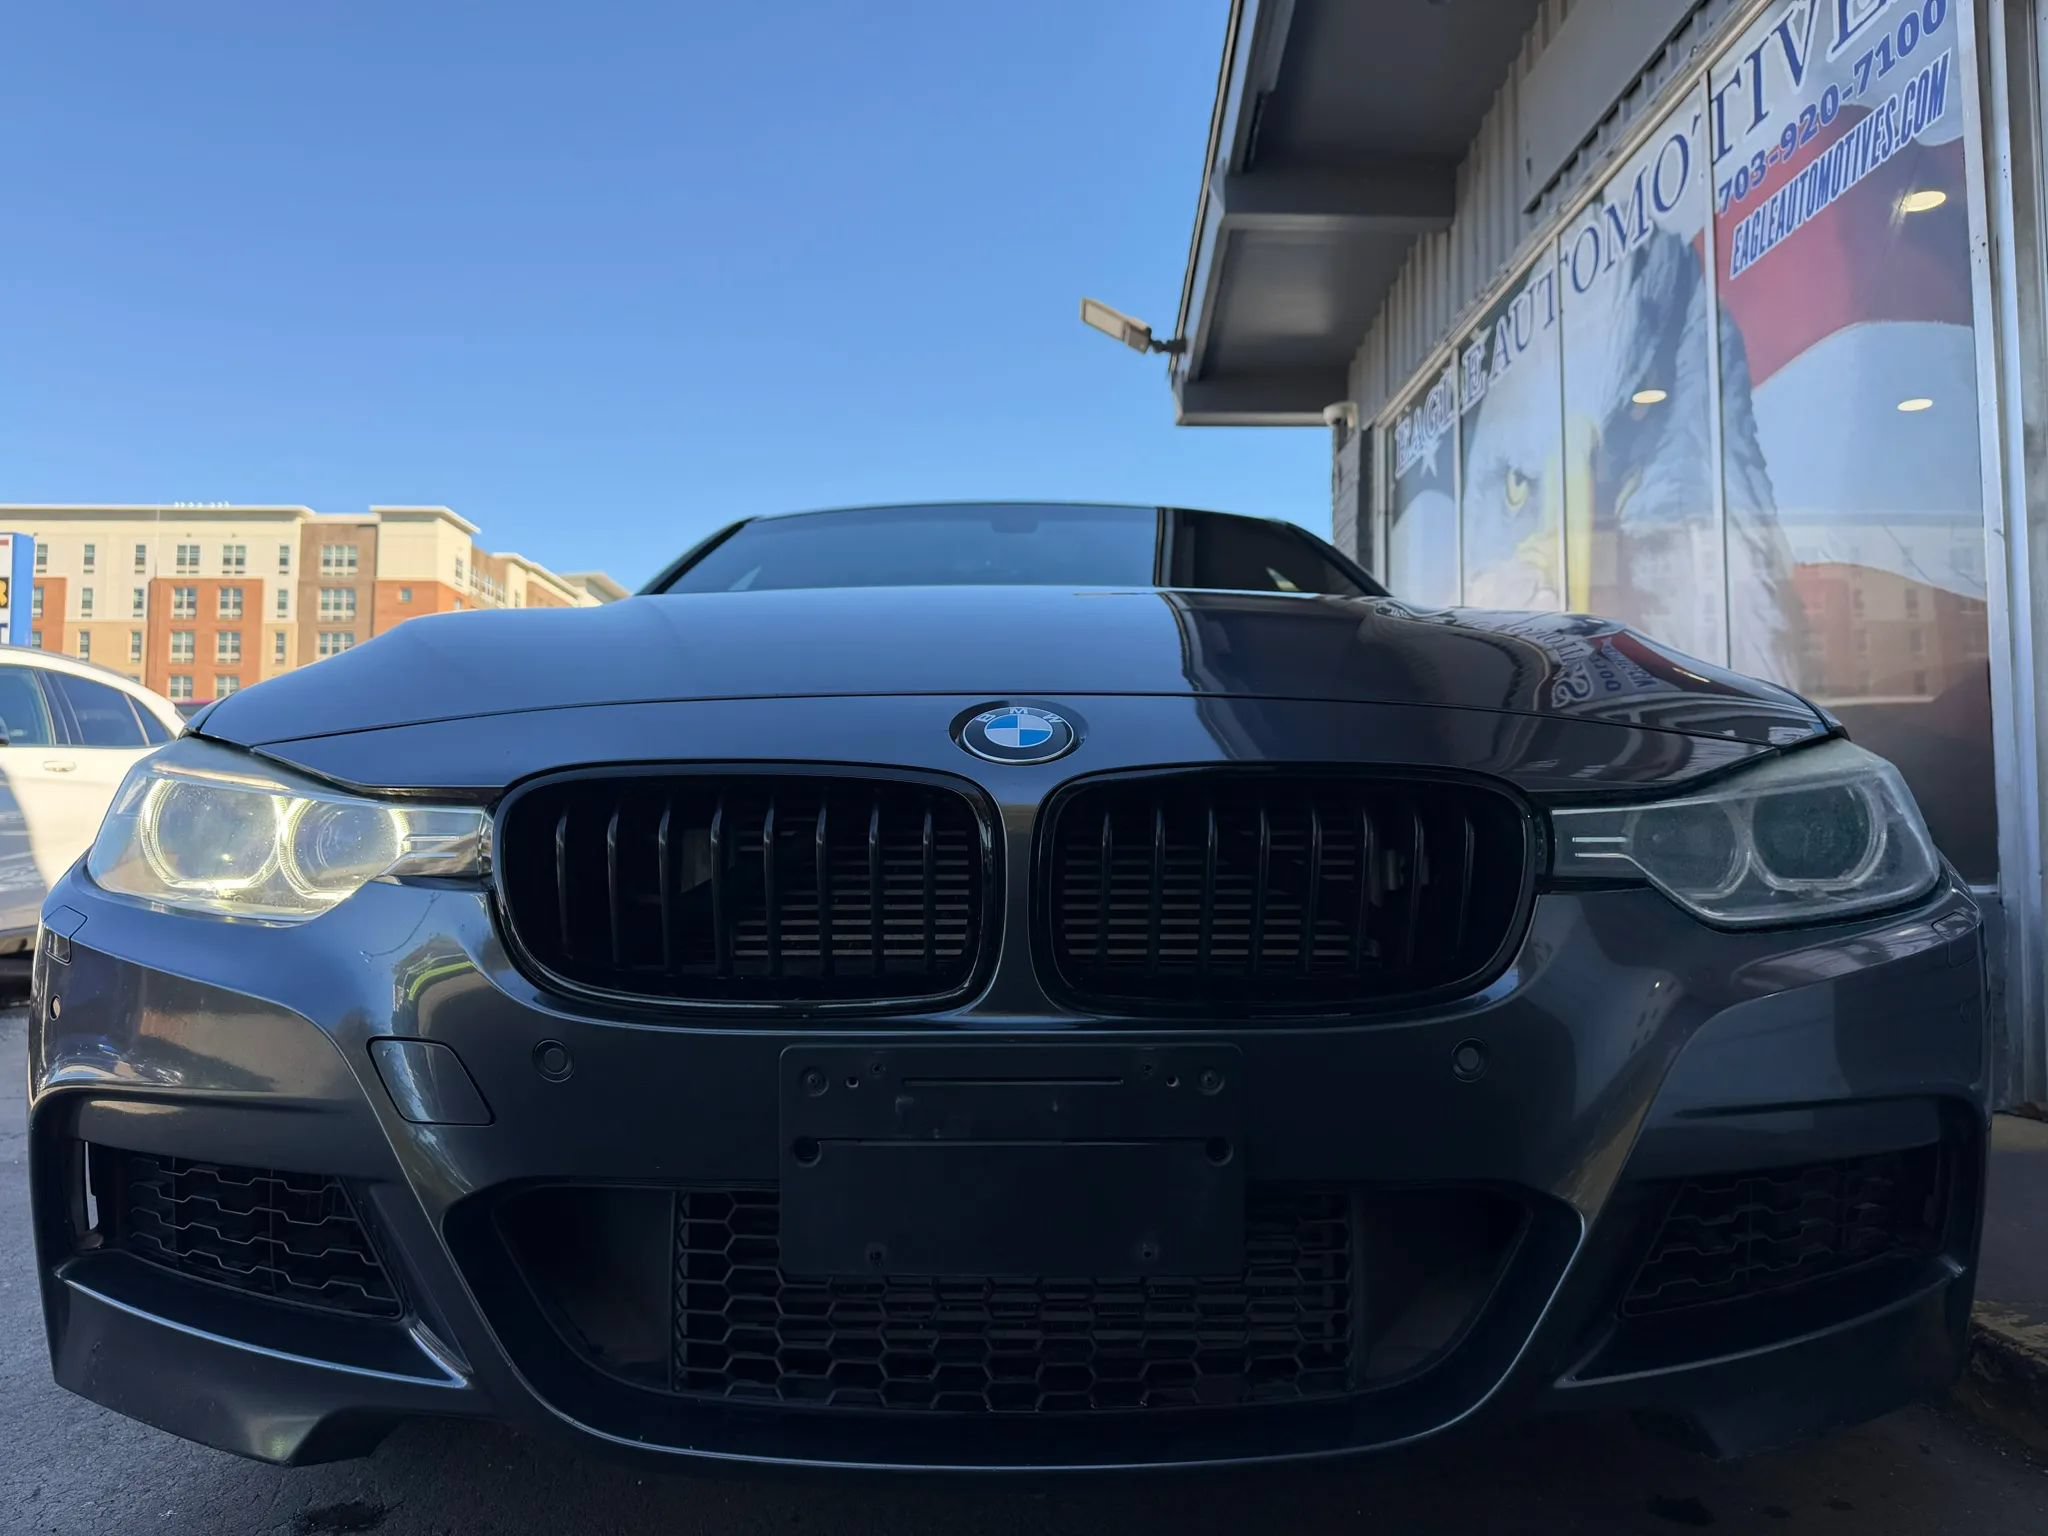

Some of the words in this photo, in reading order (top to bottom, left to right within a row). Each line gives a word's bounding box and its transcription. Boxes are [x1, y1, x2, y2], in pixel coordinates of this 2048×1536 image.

[1718, 0, 1948, 217] 703-920-7100
[1730, 48, 1952, 280] EAGLEAUTOMOTIVES.COM
[1395, 341, 1489, 479] EAGLE
